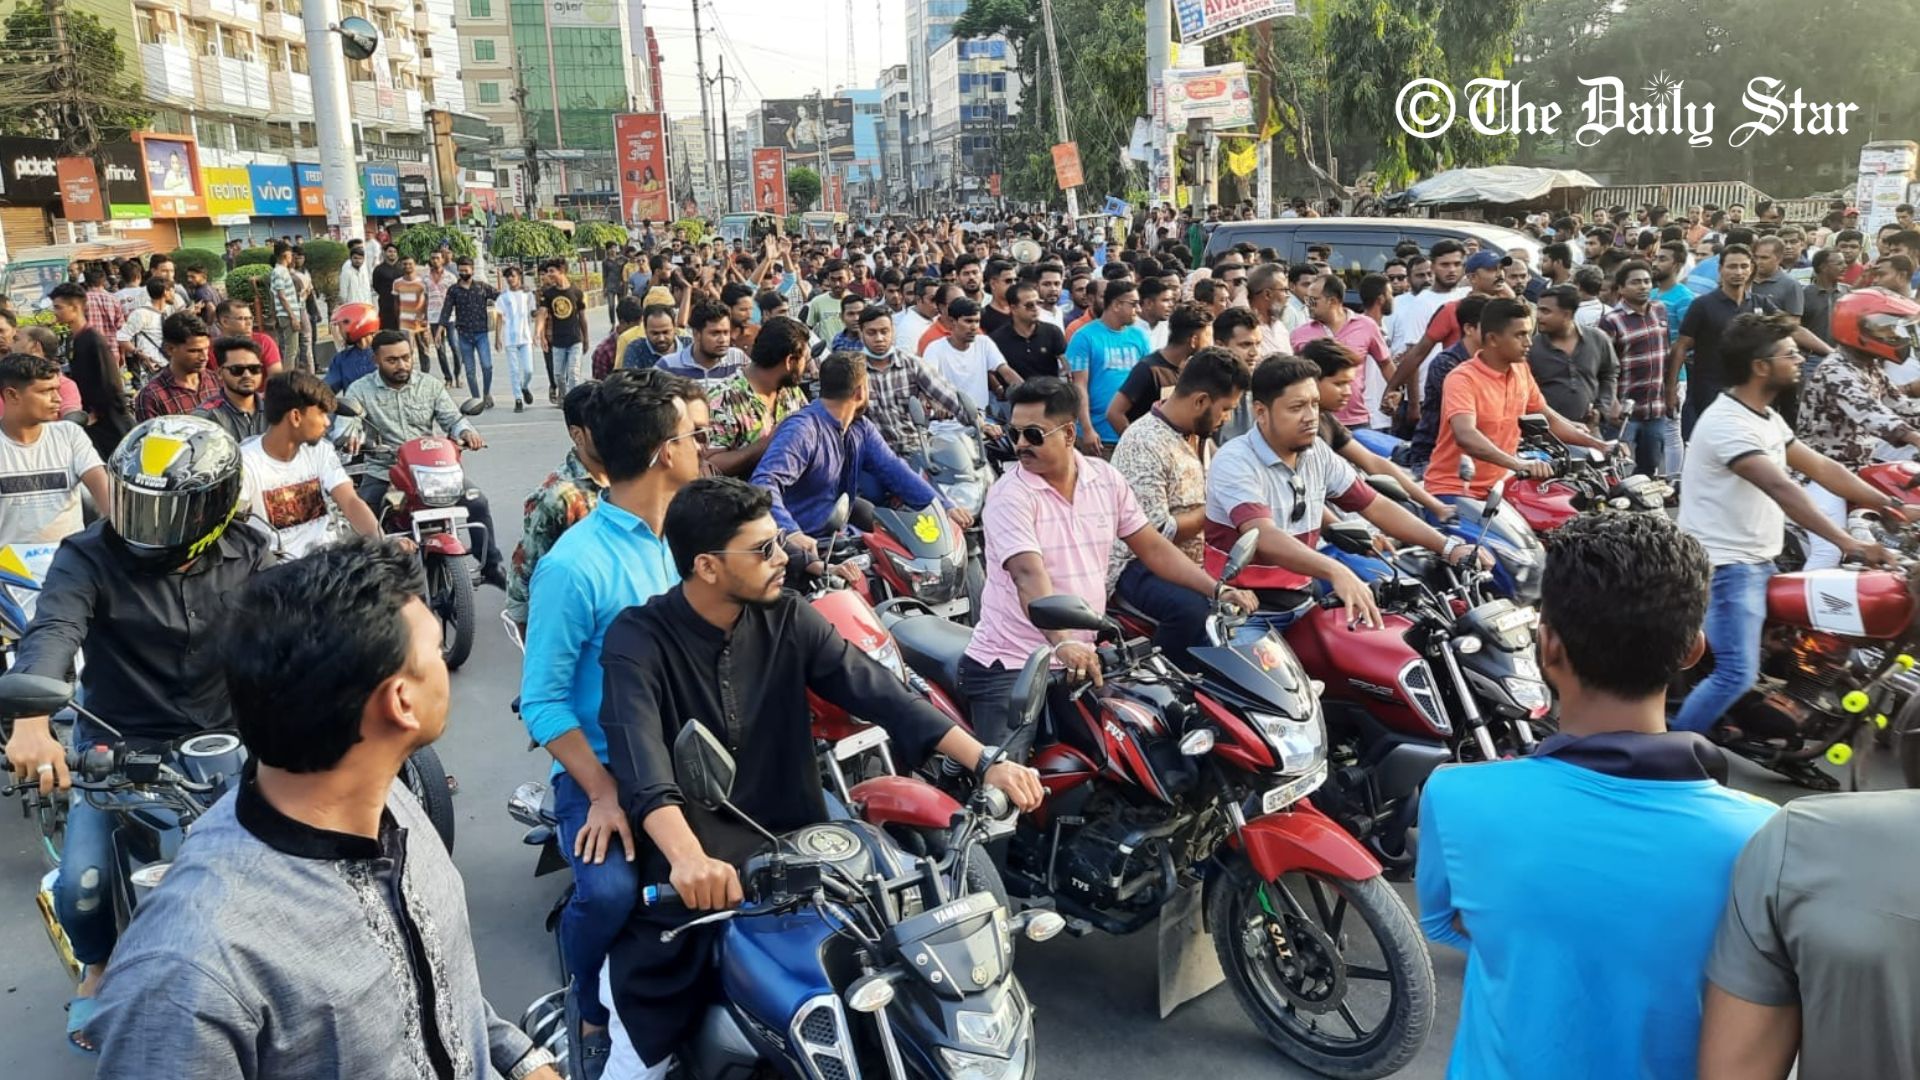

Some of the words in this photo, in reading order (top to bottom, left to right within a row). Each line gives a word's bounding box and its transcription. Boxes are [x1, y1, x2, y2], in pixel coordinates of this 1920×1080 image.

[370, 173, 396, 187] TECNO
[208, 184, 249, 201] realme
[257, 181, 293, 201] vivo
[375, 194, 396, 209] vivo
[1105, 720, 1126, 742] TVS
[1071, 876, 1090, 892] TVS
[932, 901, 972, 925] YAMAHA
